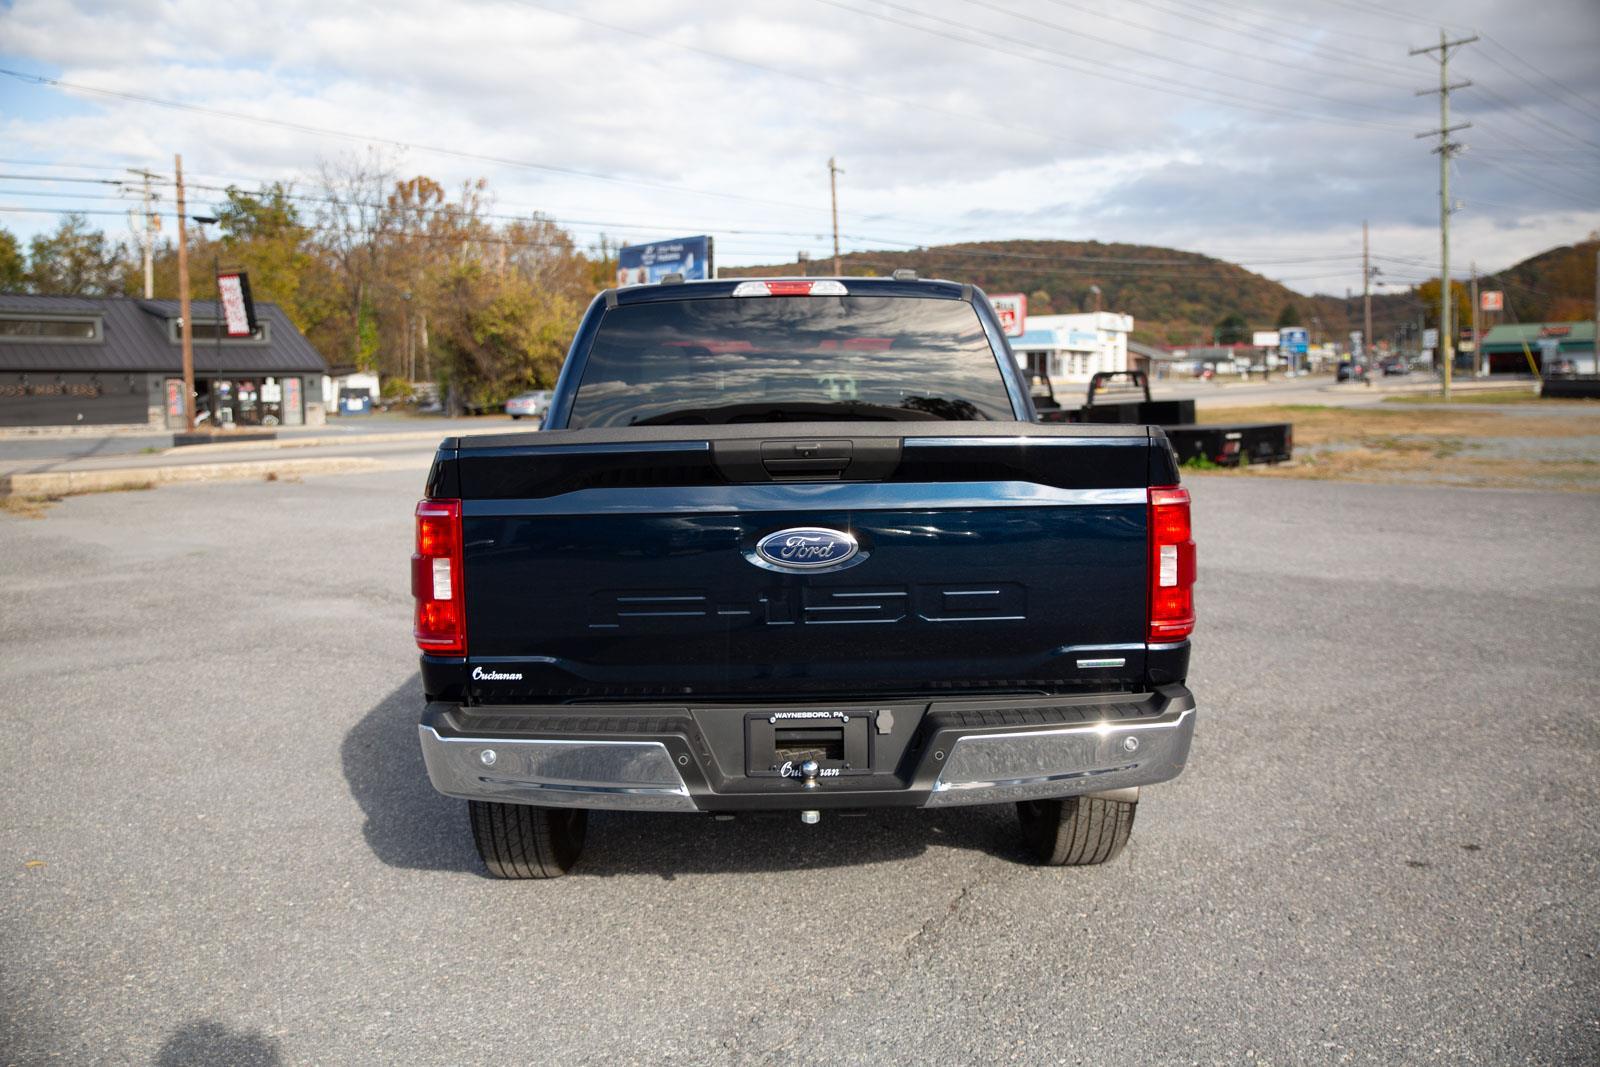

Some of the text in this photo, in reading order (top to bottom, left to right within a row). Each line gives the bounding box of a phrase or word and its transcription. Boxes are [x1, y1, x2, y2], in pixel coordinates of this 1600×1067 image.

[781, 536, 835, 559] Ford
[588, 582, 1028, 628] F-150
[472, 666, 523, 680] Buchanan
[774, 711, 831, 719] WAYNESBORO,
[780, 761, 840, 777] Bunan
